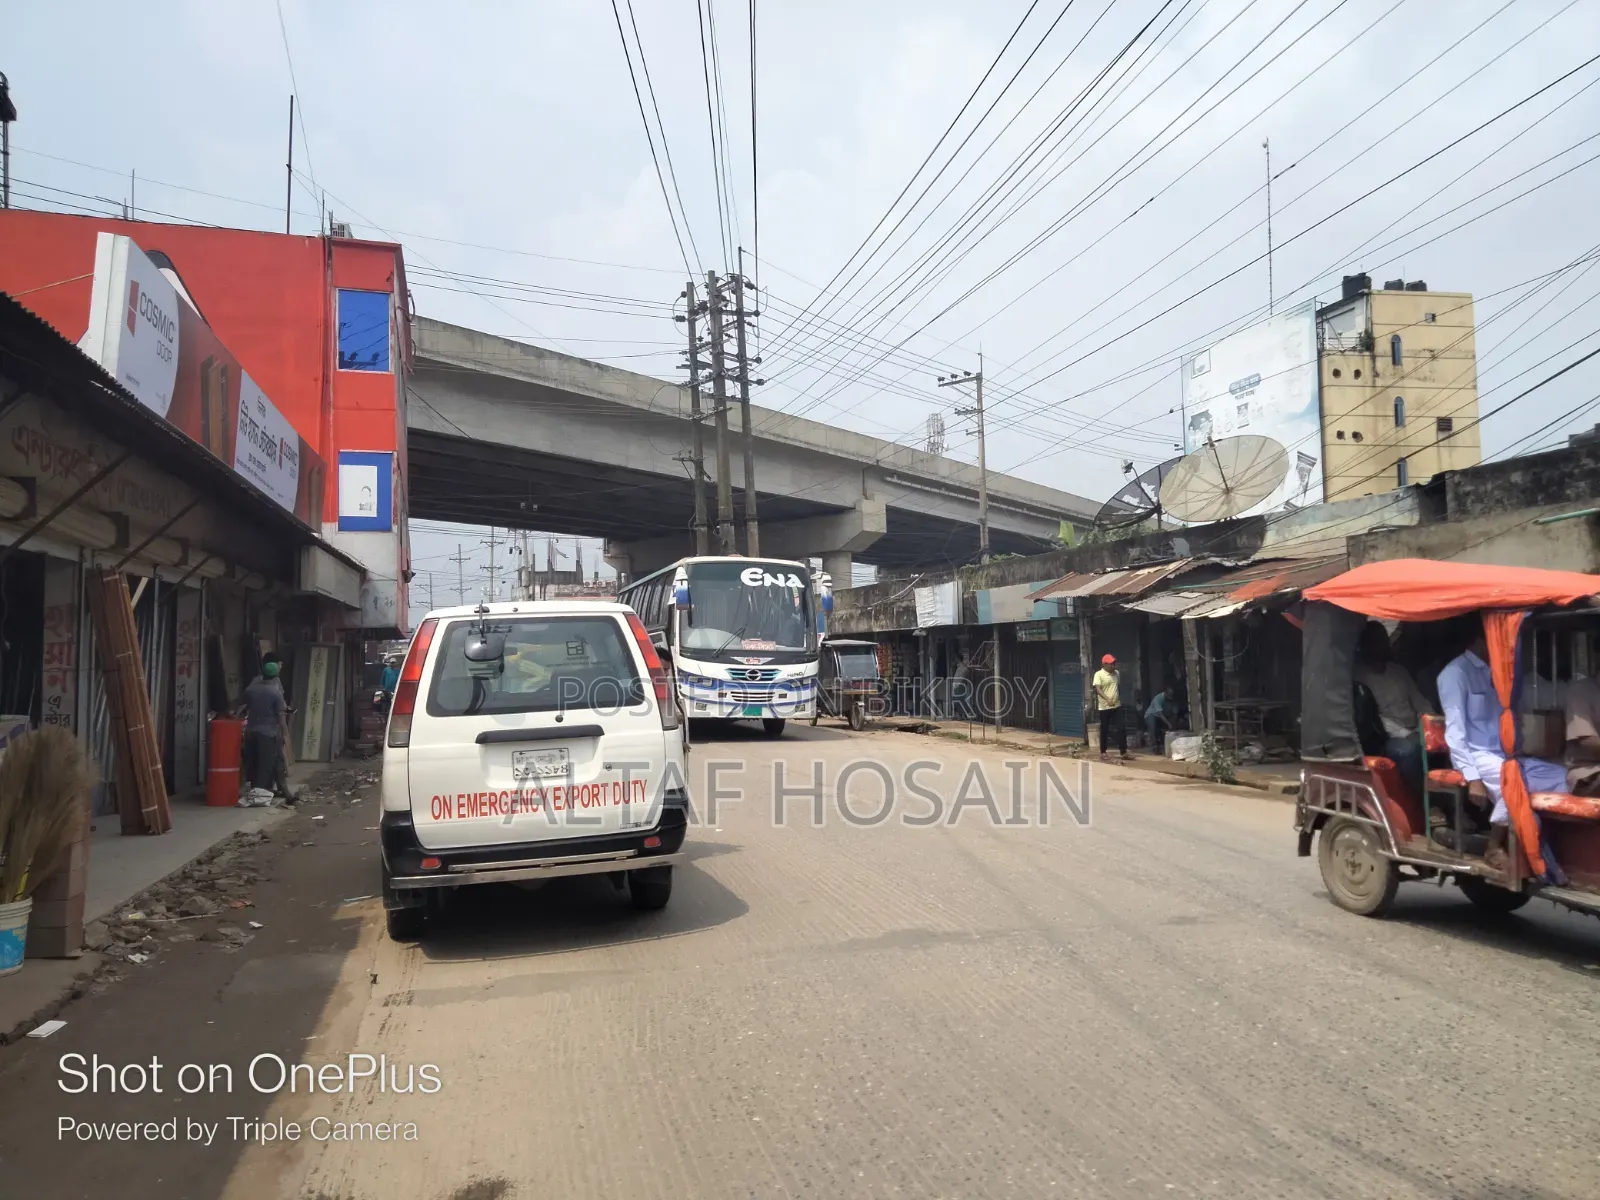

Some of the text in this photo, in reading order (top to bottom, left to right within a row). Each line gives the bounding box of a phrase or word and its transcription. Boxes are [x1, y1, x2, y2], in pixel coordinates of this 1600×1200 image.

[140, 291, 175, 344] COSMIC
[156, 339, 173, 363] DOOR
[431, 779, 648, 820] ON EMERGENCY EXPORT DUTY
